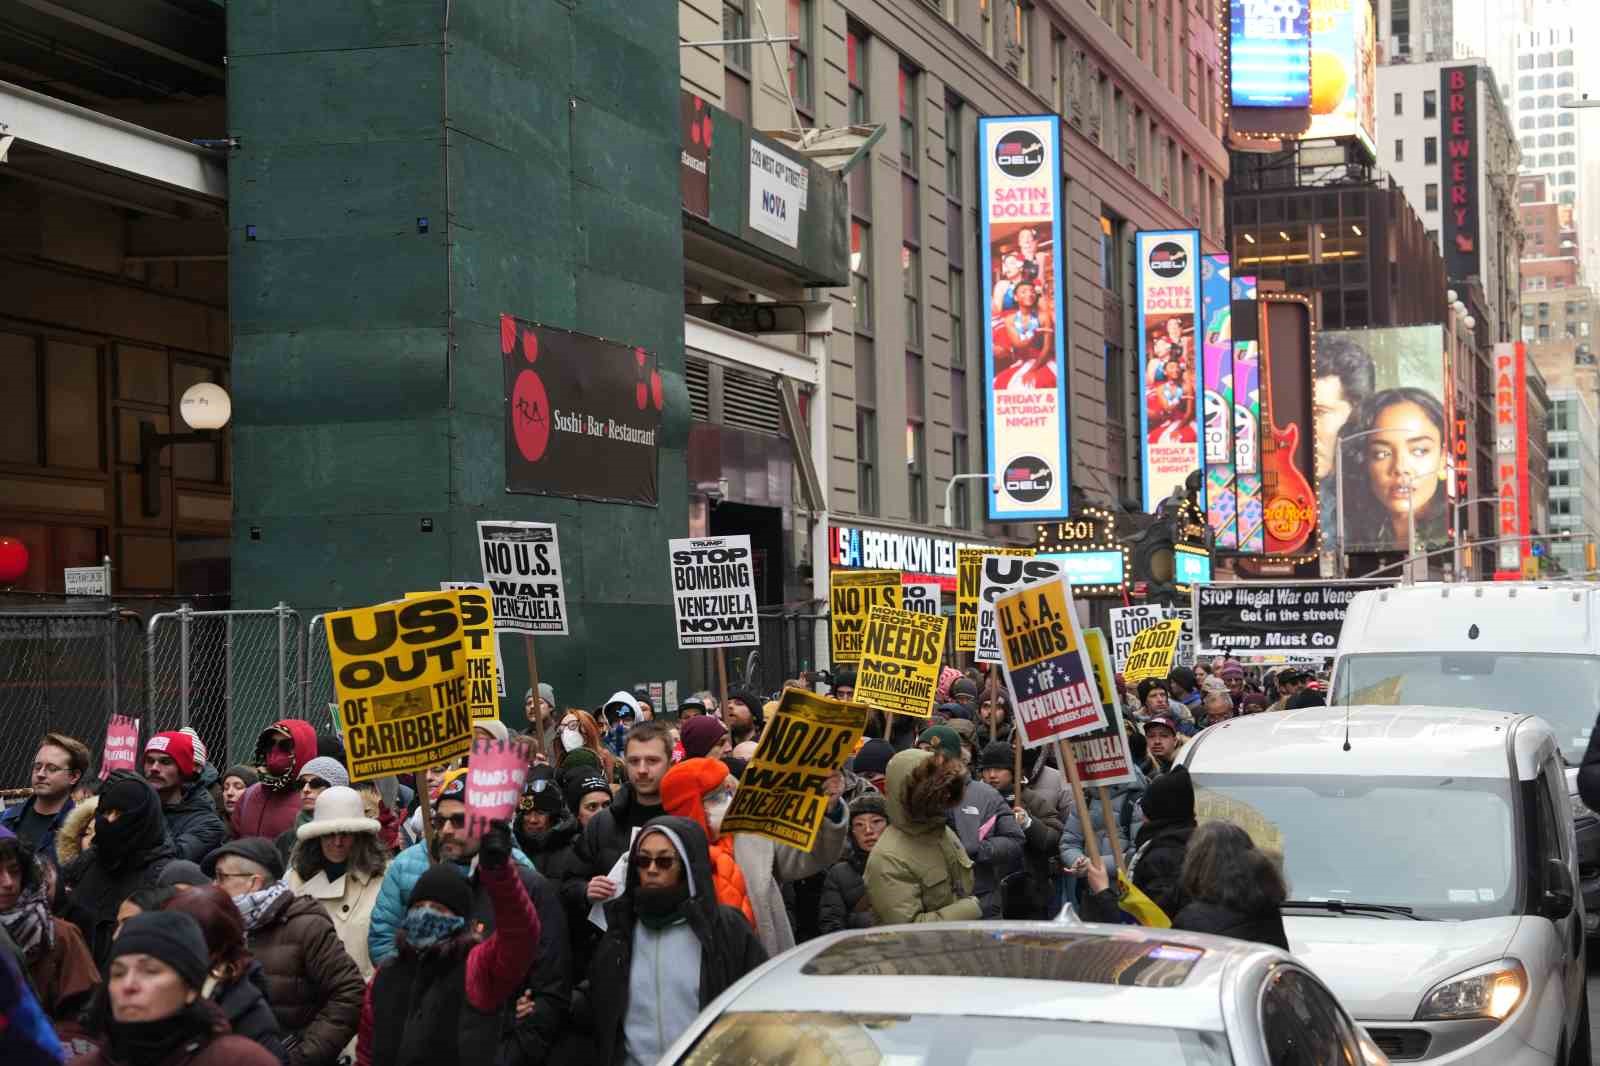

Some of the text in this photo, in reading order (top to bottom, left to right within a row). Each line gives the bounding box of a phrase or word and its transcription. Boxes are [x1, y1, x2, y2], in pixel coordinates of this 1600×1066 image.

[1450, 71, 1469, 225] BREWERY
[762, 153, 775, 176] WEST
[998, 155, 1042, 165] DELI
[762, 189, 786, 221] NOVA
[994, 187, 1048, 201] SATIN
[992, 203, 1051, 217] DOLLZ
[1148, 286, 1190, 298] SATIN
[1146, 298, 1193, 310] DOLLZ
[996, 394, 1055, 405] FRIDAY &
[1496, 355, 1512, 424] PARK
[996, 404, 1056, 416] SATURDAY
[554, 409, 655, 446] Sushi Bar Restaurant
[1005, 416, 1048, 428] NIGHT
[1150, 447, 1186, 456] FRIDAY
[1150, 455, 1196, 464] SATURDAY
[1157, 465, 1189, 474] NIGHT
[1006, 480, 1050, 491] DELI
[1500, 463, 1517, 536] PARK
[483, 541, 557, 576] NO U.S.
[673, 548, 748, 566] STOP
[829, 527, 958, 577] USA BROOKLYN DELI
[674, 563, 750, 591] BOMBING
[985, 557, 1060, 584] US
[488, 580, 560, 599] WAR
[1201, 590, 1233, 606] STOP
[1235, 588, 1274, 609] Illegal
[1277, 589, 1301, 605] War
[1303, 593, 1320, 605] on
[492, 597, 562, 620] VENEZUELA
[678, 593, 753, 617] VENEZUELA
[833, 587, 860, 616] NO
[1121, 607, 1149, 618] NO
[680, 616, 754, 633] NOW!
[870, 613, 943, 633] PEOPLE'S
[871, 606, 945, 625] MONEY FOR
[959, 616, 977, 631] WA
[1000, 593, 1061, 636] U.S.A.
[1240, 609, 1345, 622] Get in the streets
[331, 598, 459, 656] US
[865, 622, 941, 665] NEEDS
[1006, 622, 1069, 667] HANDS
[1116, 641, 1129, 661] FO
[1133, 630, 1176, 652] BLOOD
[1209, 632, 1261, 648] Trump
[1265, 632, 1307, 646] Must
[1311, 632, 1335, 646] Go
[338, 640, 462, 690] OUT
[466, 658, 492, 679] THE
[863, 658, 934, 683] NOT THE
[1125, 652, 1148, 673] FOR
[1149, 650, 1169, 667] OIL
[861, 672, 933, 699] WAR MACHINE
[343, 697, 368, 727] OF
[433, 676, 468, 710] THE
[348, 702, 471, 759] CARIBBEAN
[754, 714, 854, 770] NO U.S.
[743, 766, 826, 796] WAR
[727, 788, 821, 831] VENEZUELA
